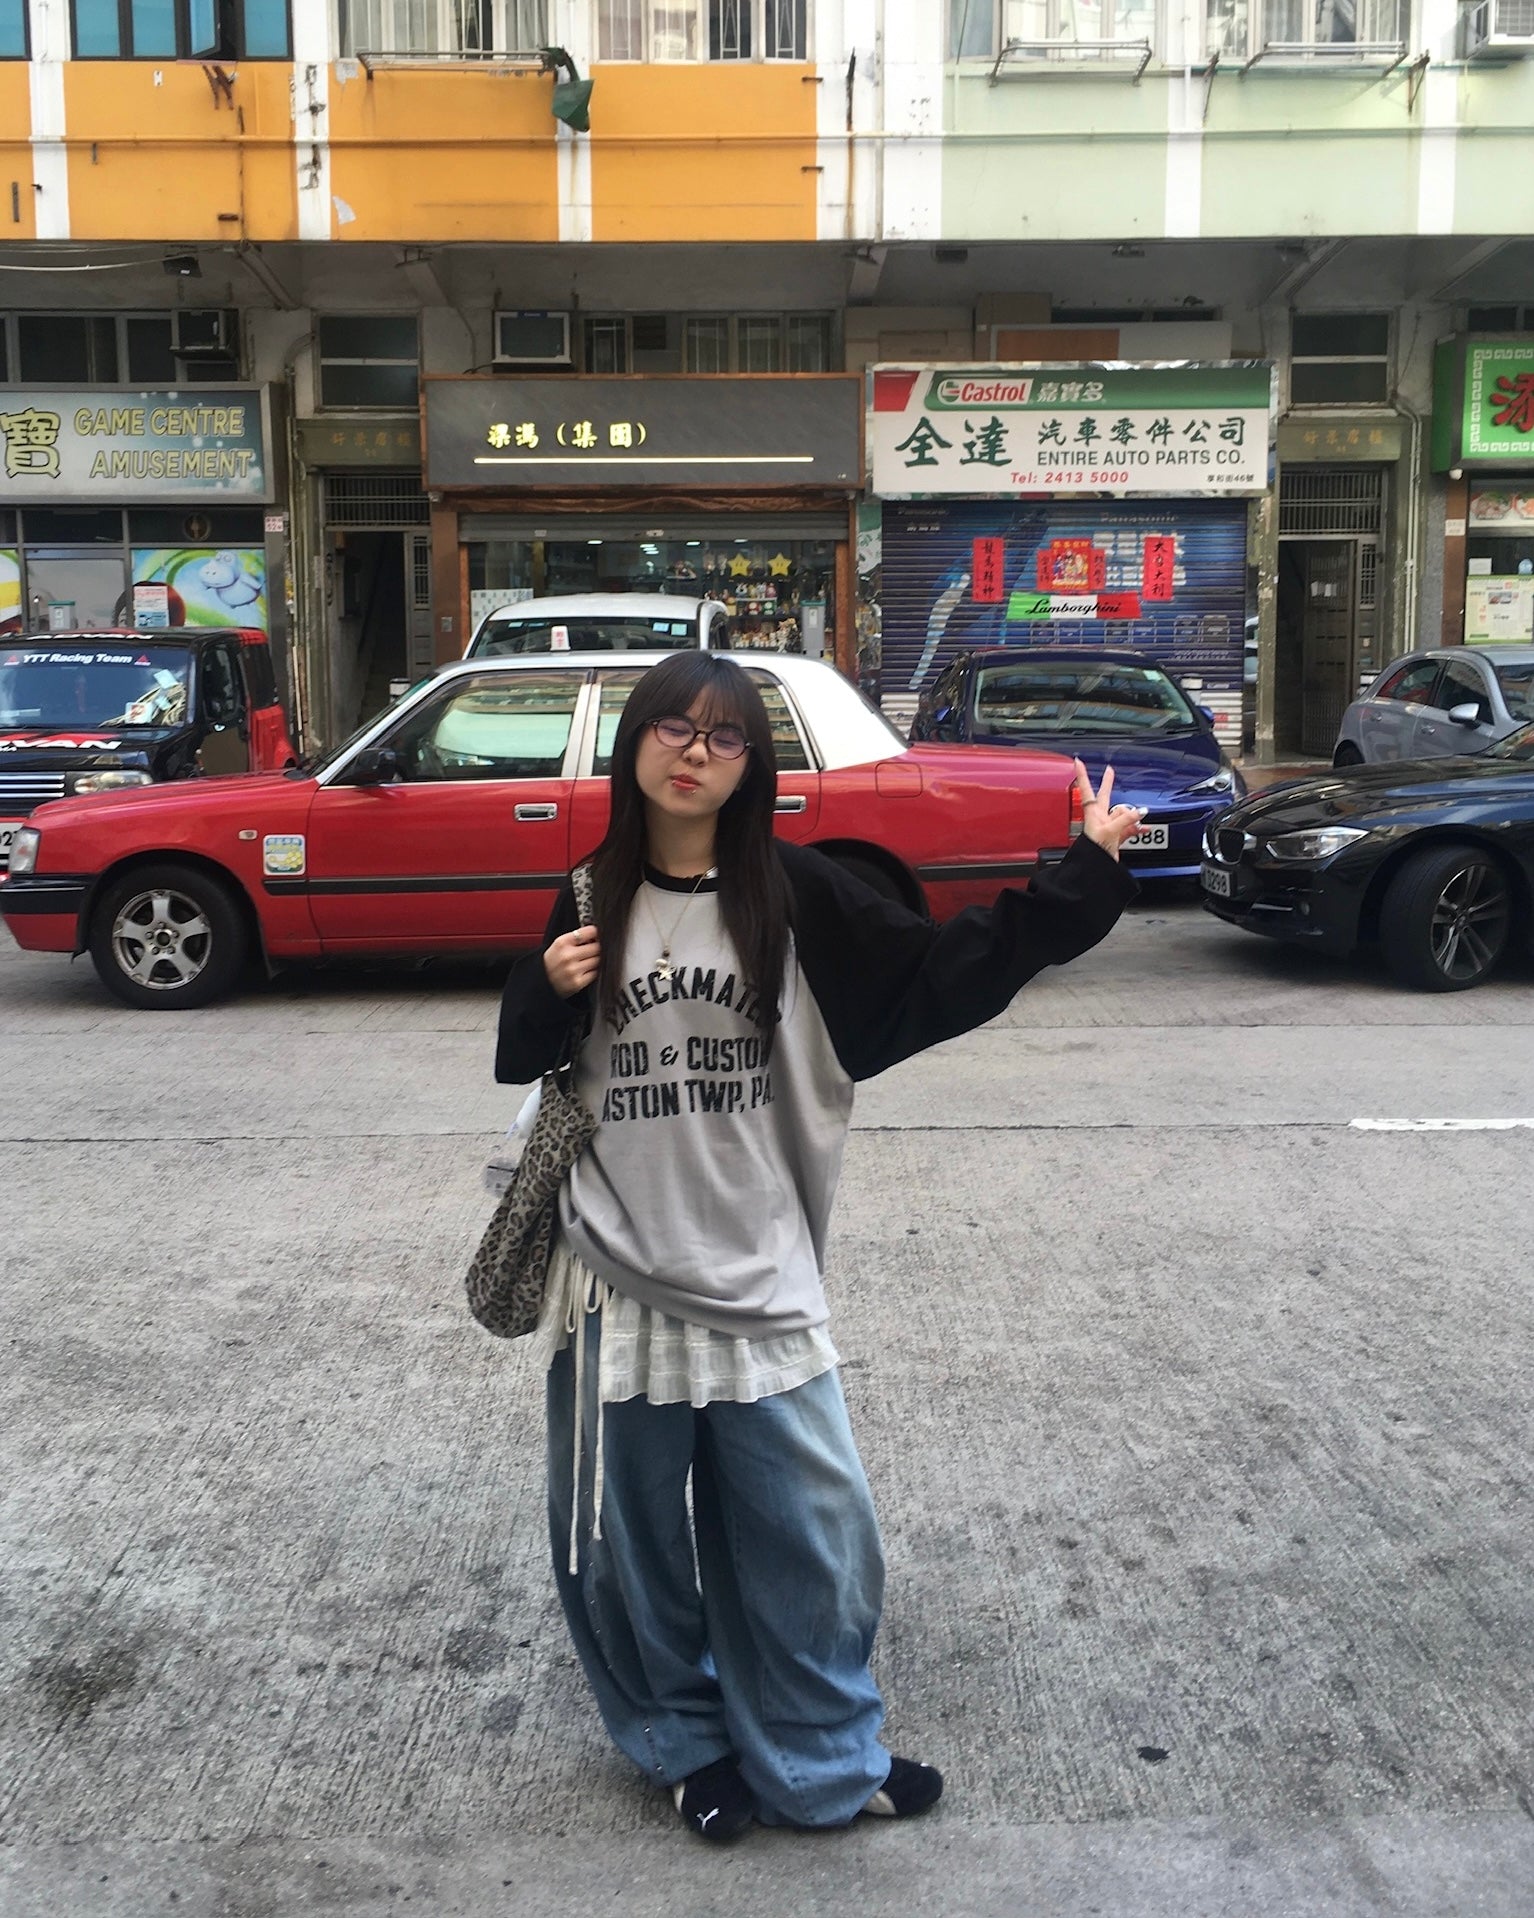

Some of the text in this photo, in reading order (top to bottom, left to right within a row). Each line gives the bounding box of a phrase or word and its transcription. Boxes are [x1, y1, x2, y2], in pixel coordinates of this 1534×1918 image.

[961, 382, 1027, 402] Castrol
[74, 406, 245, 438] GAME CENTRE
[1037, 417, 1246, 447] 汽車零件公司
[895, 416, 1013, 468] 全達
[89, 448, 254, 480] AMUSEMENT
[1037, 448, 1246, 467] ENTIRE AUTO PARTS CO.
[1010, 470, 1130, 484] Tel: 2413 5000
[1025, 598, 1122, 616] Lamborghini
[23, 653, 51, 664] YTT
[49, 653, 94, 664] Racing
[96, 653, 133, 664] Team
[659, 1044, 679, 1067] &
[684, 1078, 746, 1114] TWP,
